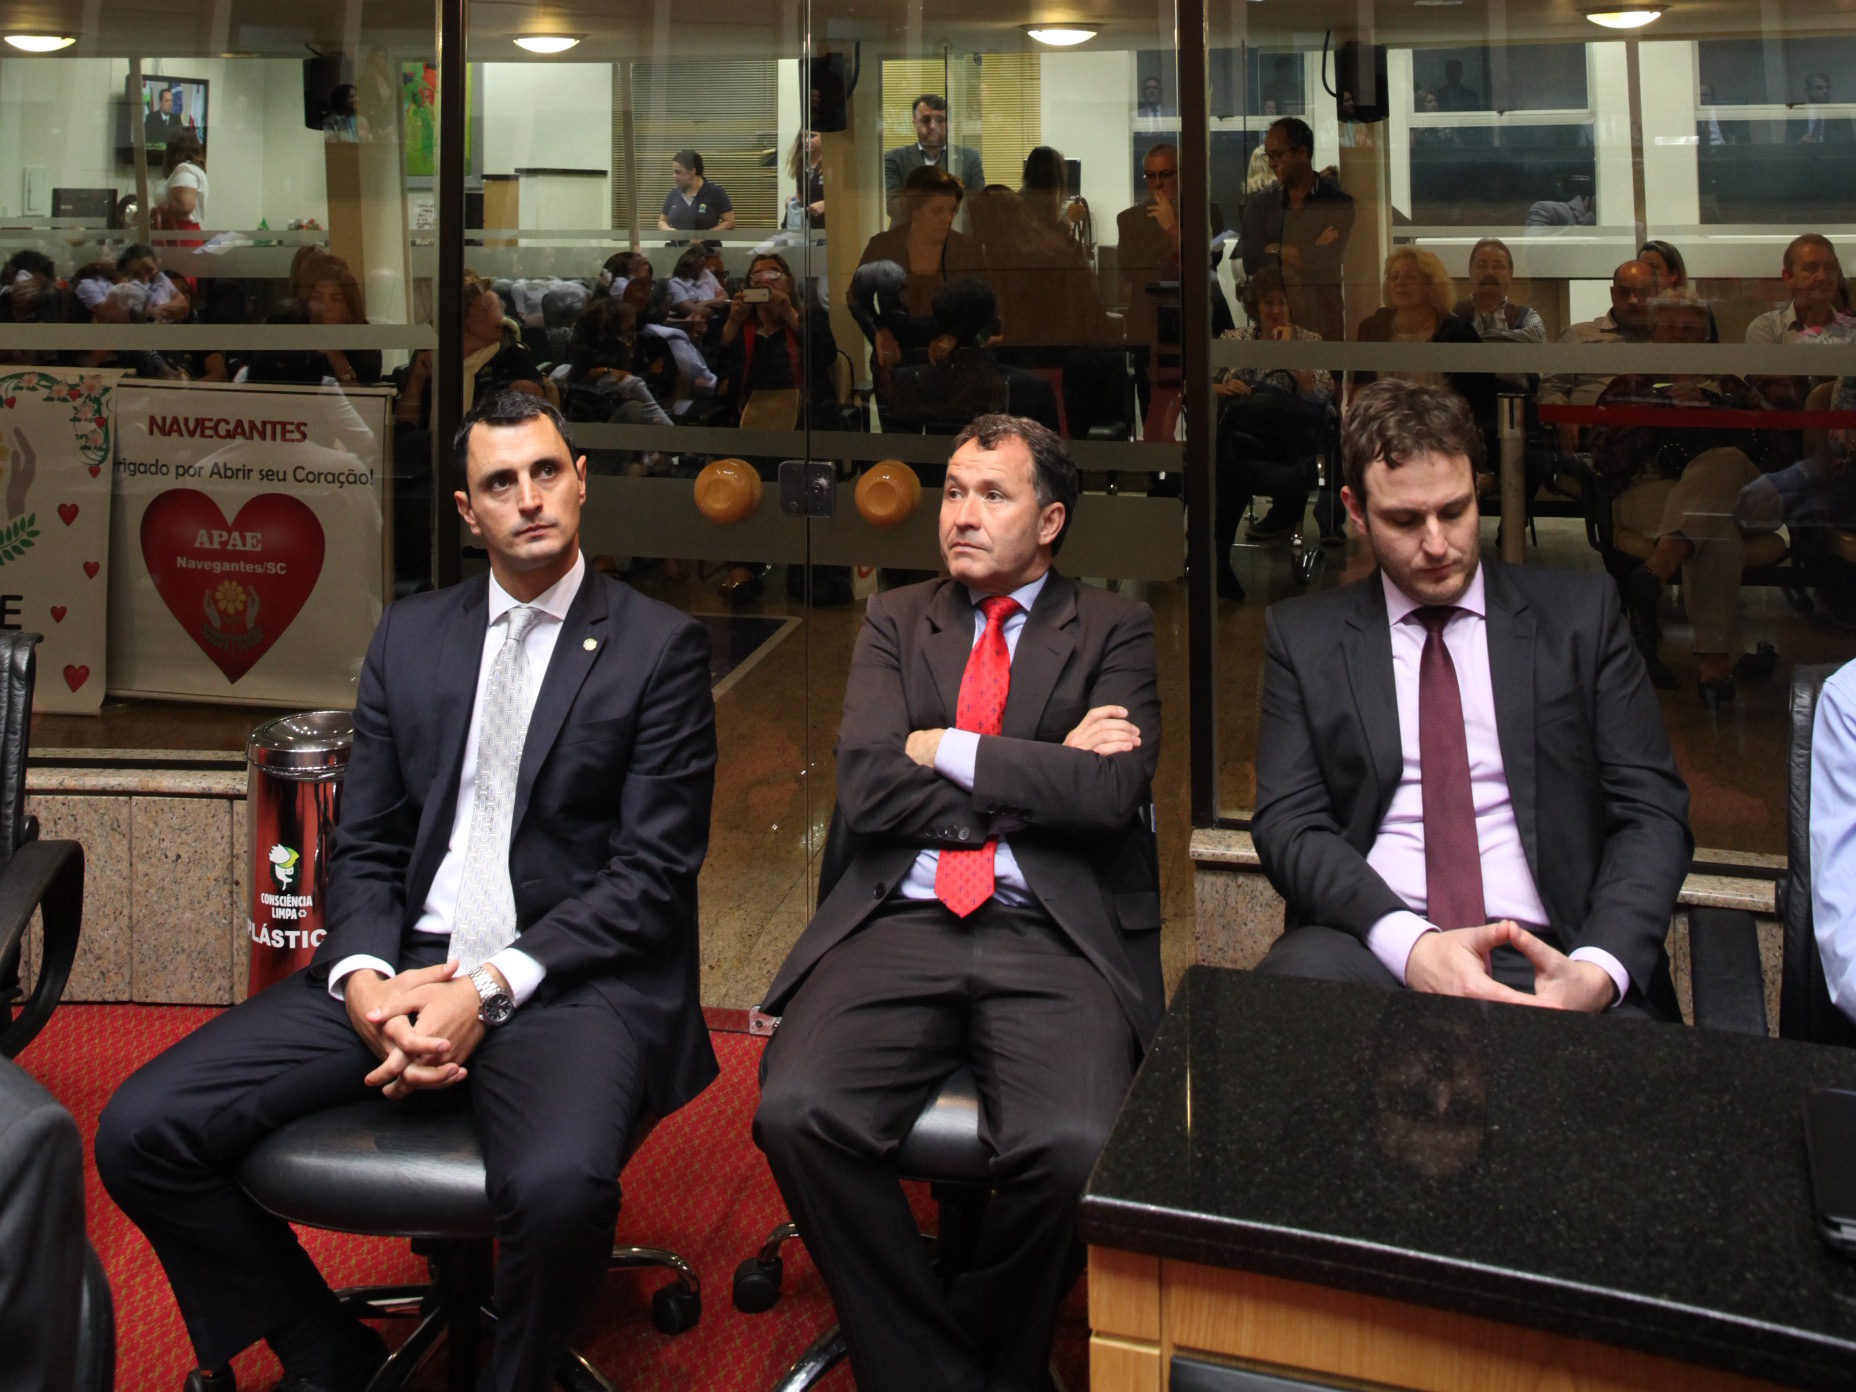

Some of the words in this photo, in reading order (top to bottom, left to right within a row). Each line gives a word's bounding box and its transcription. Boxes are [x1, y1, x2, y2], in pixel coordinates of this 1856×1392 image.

[148, 415, 308, 444] NAVEGANTES
[113, 458, 170, 477] rigado
[175, 463, 204, 480] por
[209, 462, 254, 481] Abrir
[258, 469, 287, 483] seu
[292, 465, 375, 489] Coração!
[193, 529, 262, 552] APAE
[176, 556, 287, 575] Navegantes/SC
[261, 892, 313, 907] CONSCIÊNCIA
[271, 906, 298, 920] LIMPA
